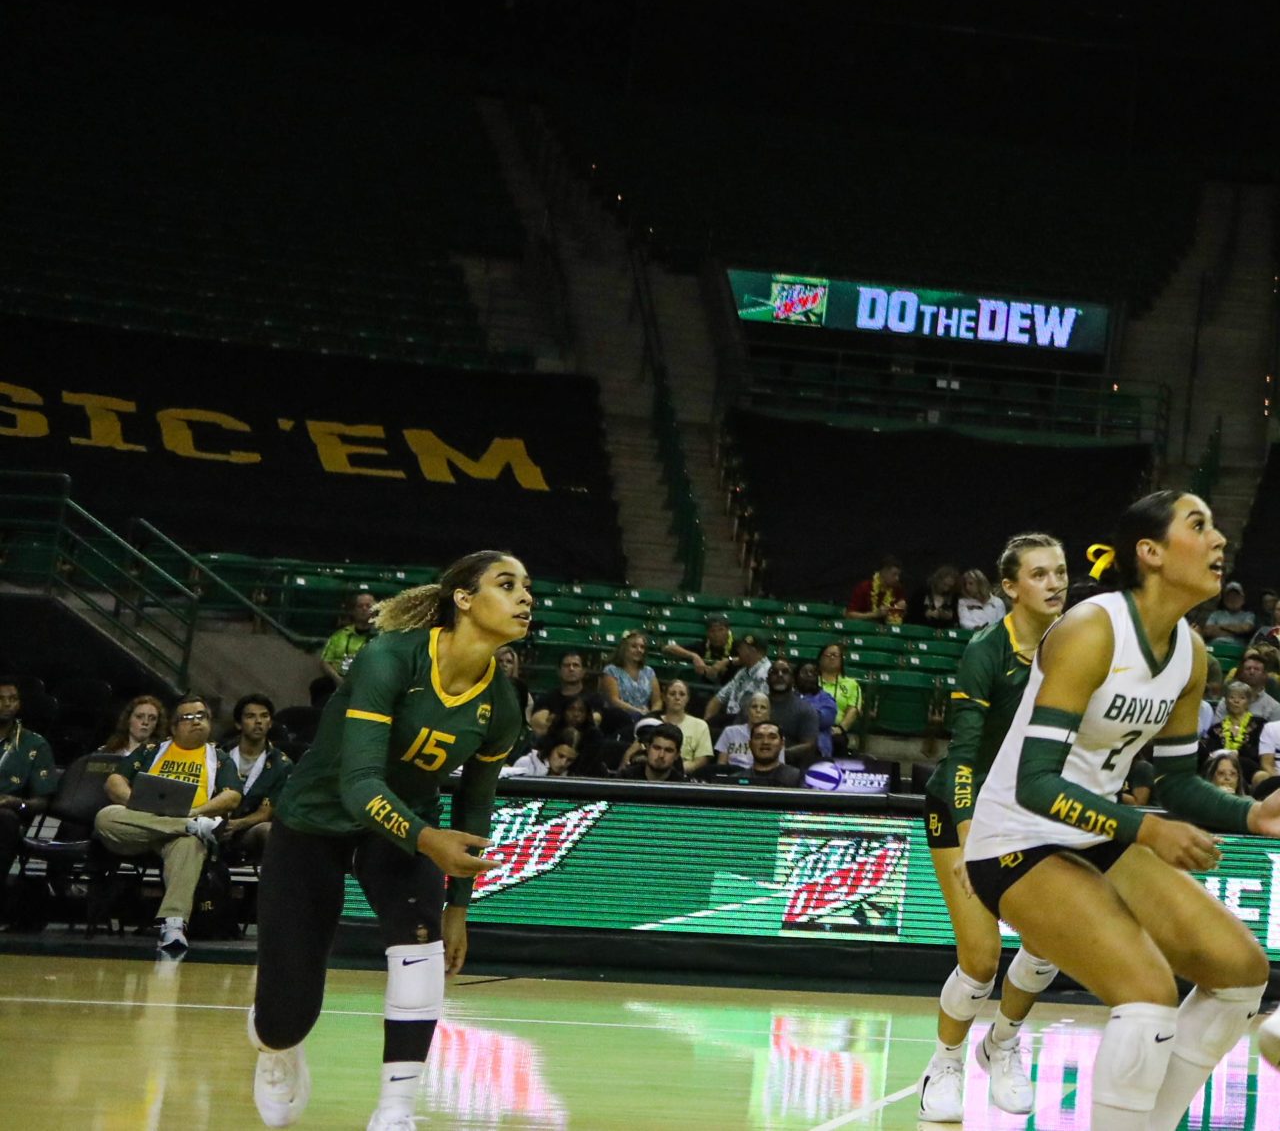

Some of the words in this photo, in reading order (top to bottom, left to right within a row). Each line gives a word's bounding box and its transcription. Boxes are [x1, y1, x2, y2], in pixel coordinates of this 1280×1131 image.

[856, 286, 918, 334] DO
[919, 305, 976, 340] THE
[976, 299, 1078, 349] DEW
[160, 760, 203, 773] BAYLOR
[400, 726, 456, 771] 15
[1101, 730, 1142, 772] 2
[845, 770, 890, 781] INSTANT
[846, 779, 888, 789] REPLAY
[365, 794, 411, 839] SIC'EM
[1049, 793, 1118, 839] SIC'EM
